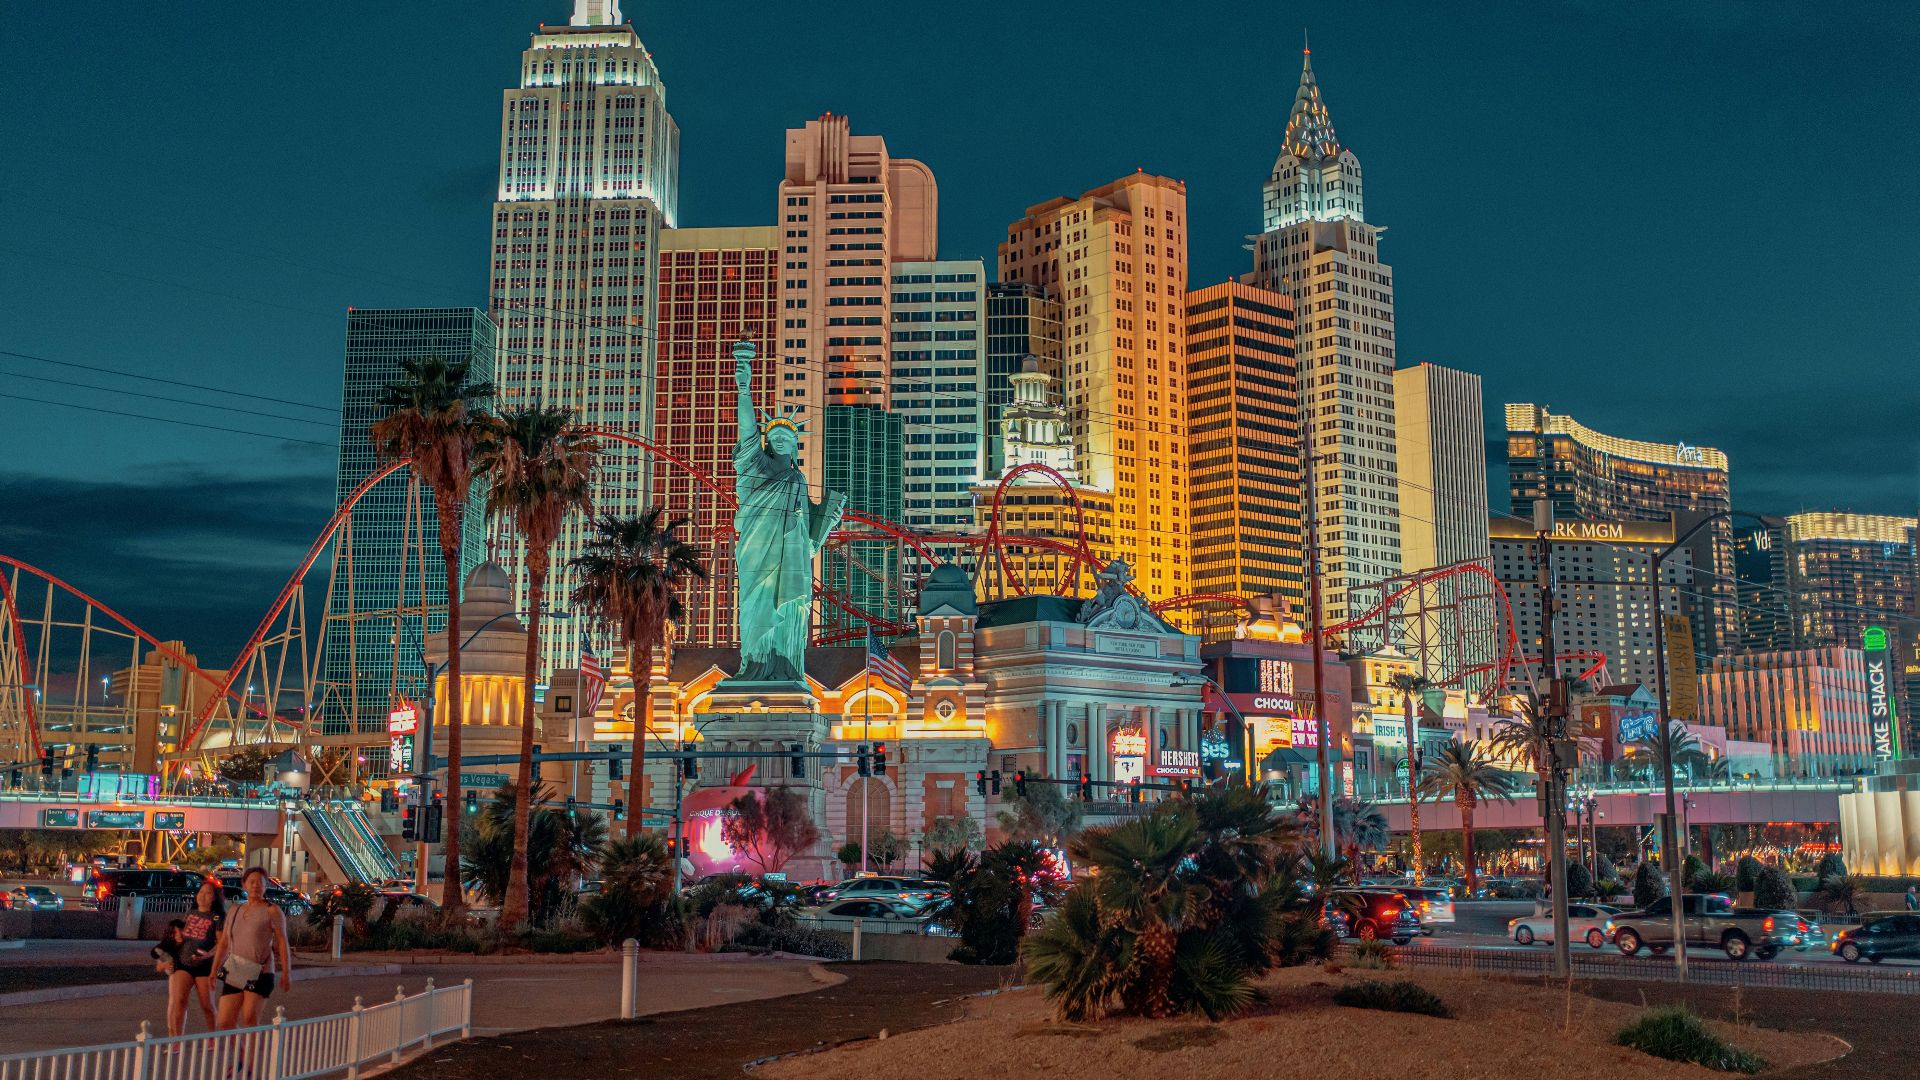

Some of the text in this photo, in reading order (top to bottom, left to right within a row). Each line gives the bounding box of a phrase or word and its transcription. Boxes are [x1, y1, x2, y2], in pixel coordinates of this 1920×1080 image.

[1552, 522, 1623, 538] RK MGM
[1254, 698, 1294, 712] CHOCOL
[1869, 660, 1891, 761] HAKE SHACK
[1291, 719, 1305, 731] EW
[1375, 725, 1408, 737] IRISH PU
[1291, 733, 1305, 744] EW
[471, 774, 496, 786] Vegas
[183, 928, 207, 940] ESS
